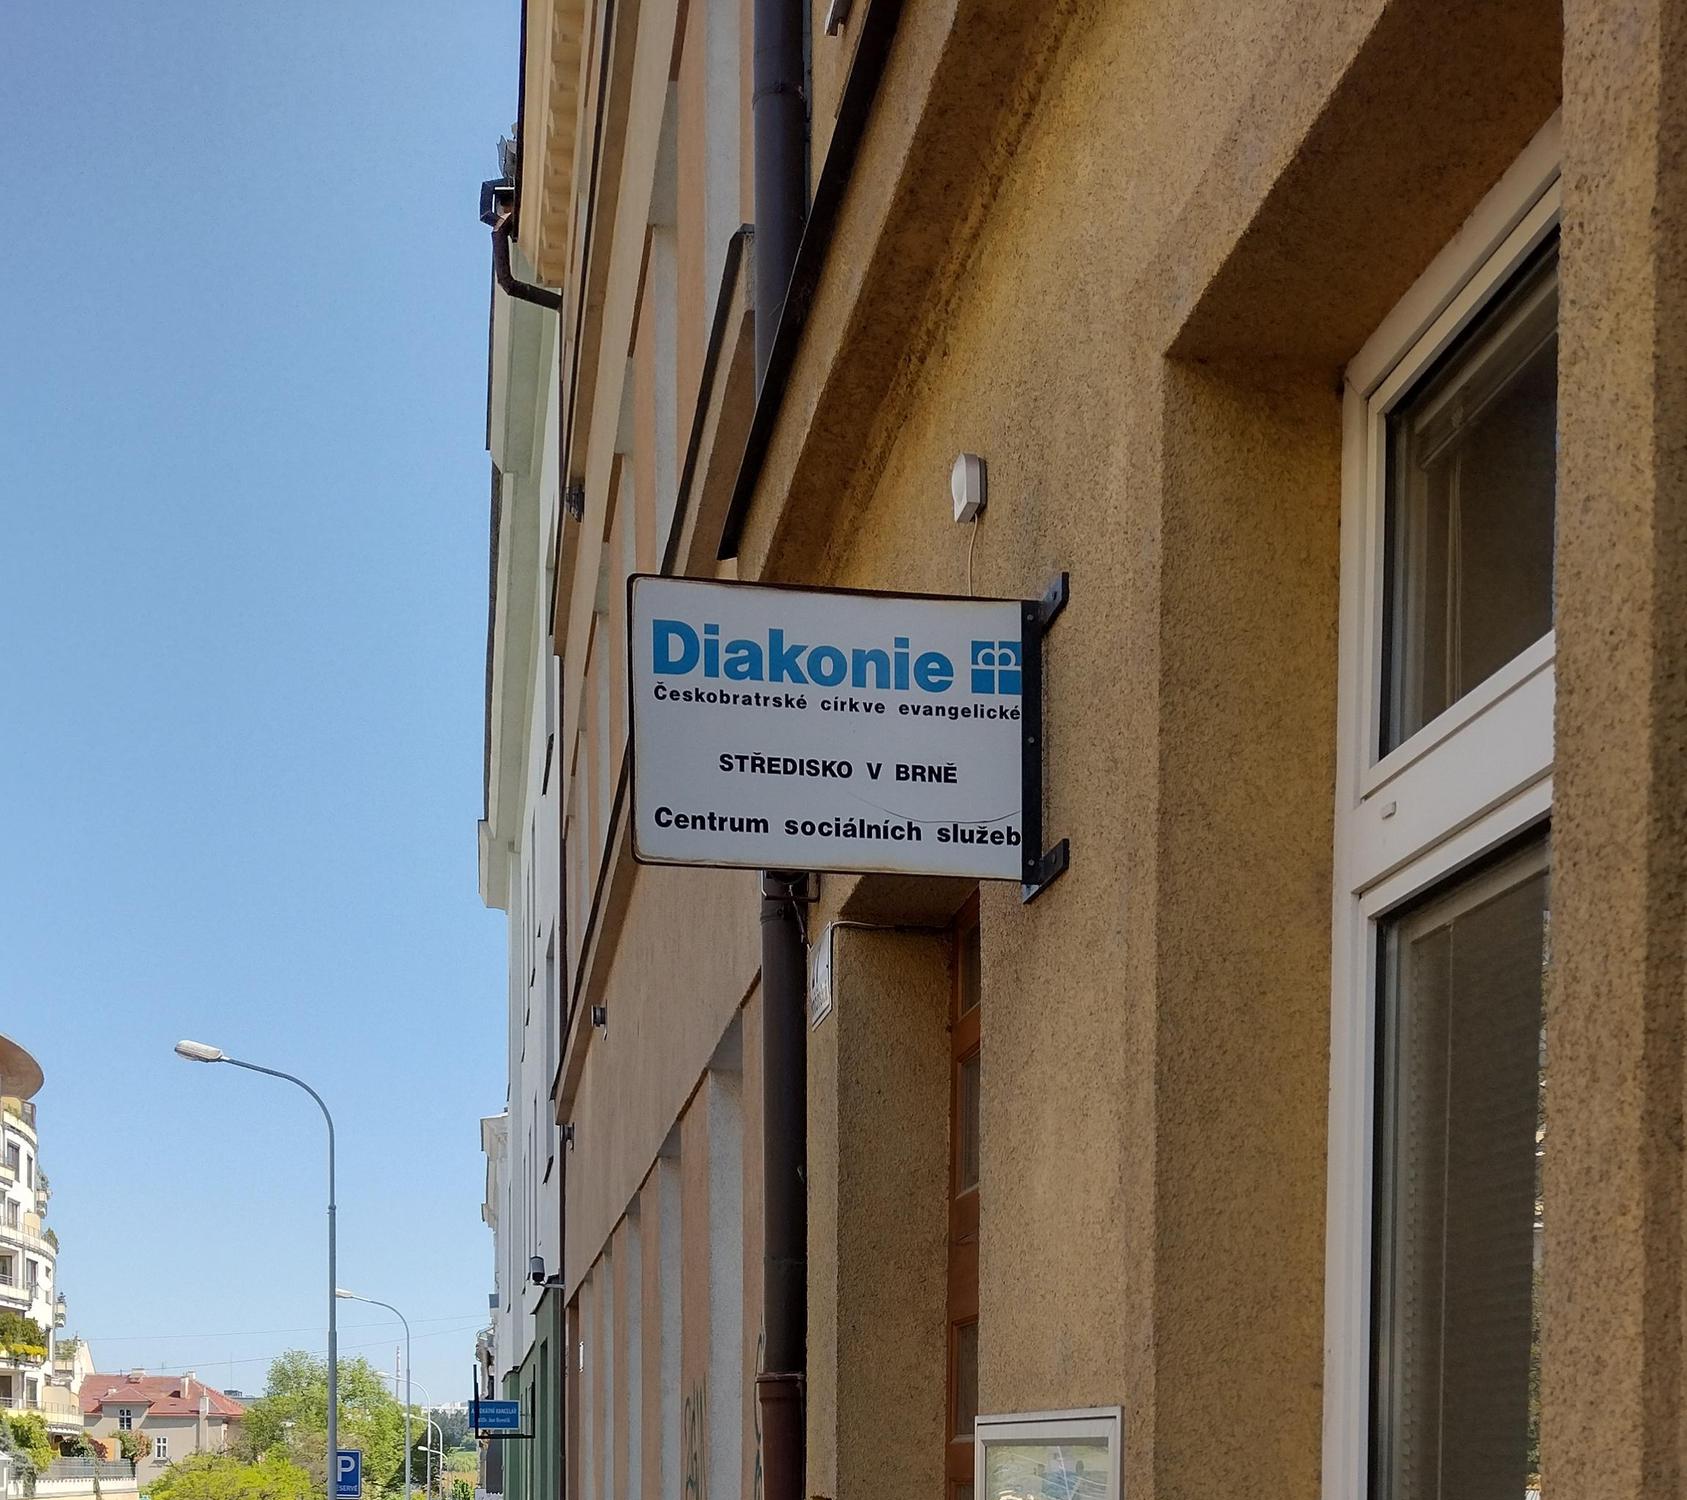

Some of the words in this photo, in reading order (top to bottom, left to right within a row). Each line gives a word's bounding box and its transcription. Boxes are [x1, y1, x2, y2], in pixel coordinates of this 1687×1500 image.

[652, 619, 955, 694] Diakonie
[653, 681, 808, 710] Českobratrské
[820, 696, 886, 714] církve
[898, 702, 1021, 721] evangelické
[719, 751, 853, 779] STŘEDISKO
[866, 762, 883, 780] V
[895, 762, 958, 784] BRNĚ
[654, 806, 769, 834] Centrum
[784, 816, 922, 842] sociálních
[936, 822, 1022, 847] služeb
[337, 1455, 356, 1482] P
